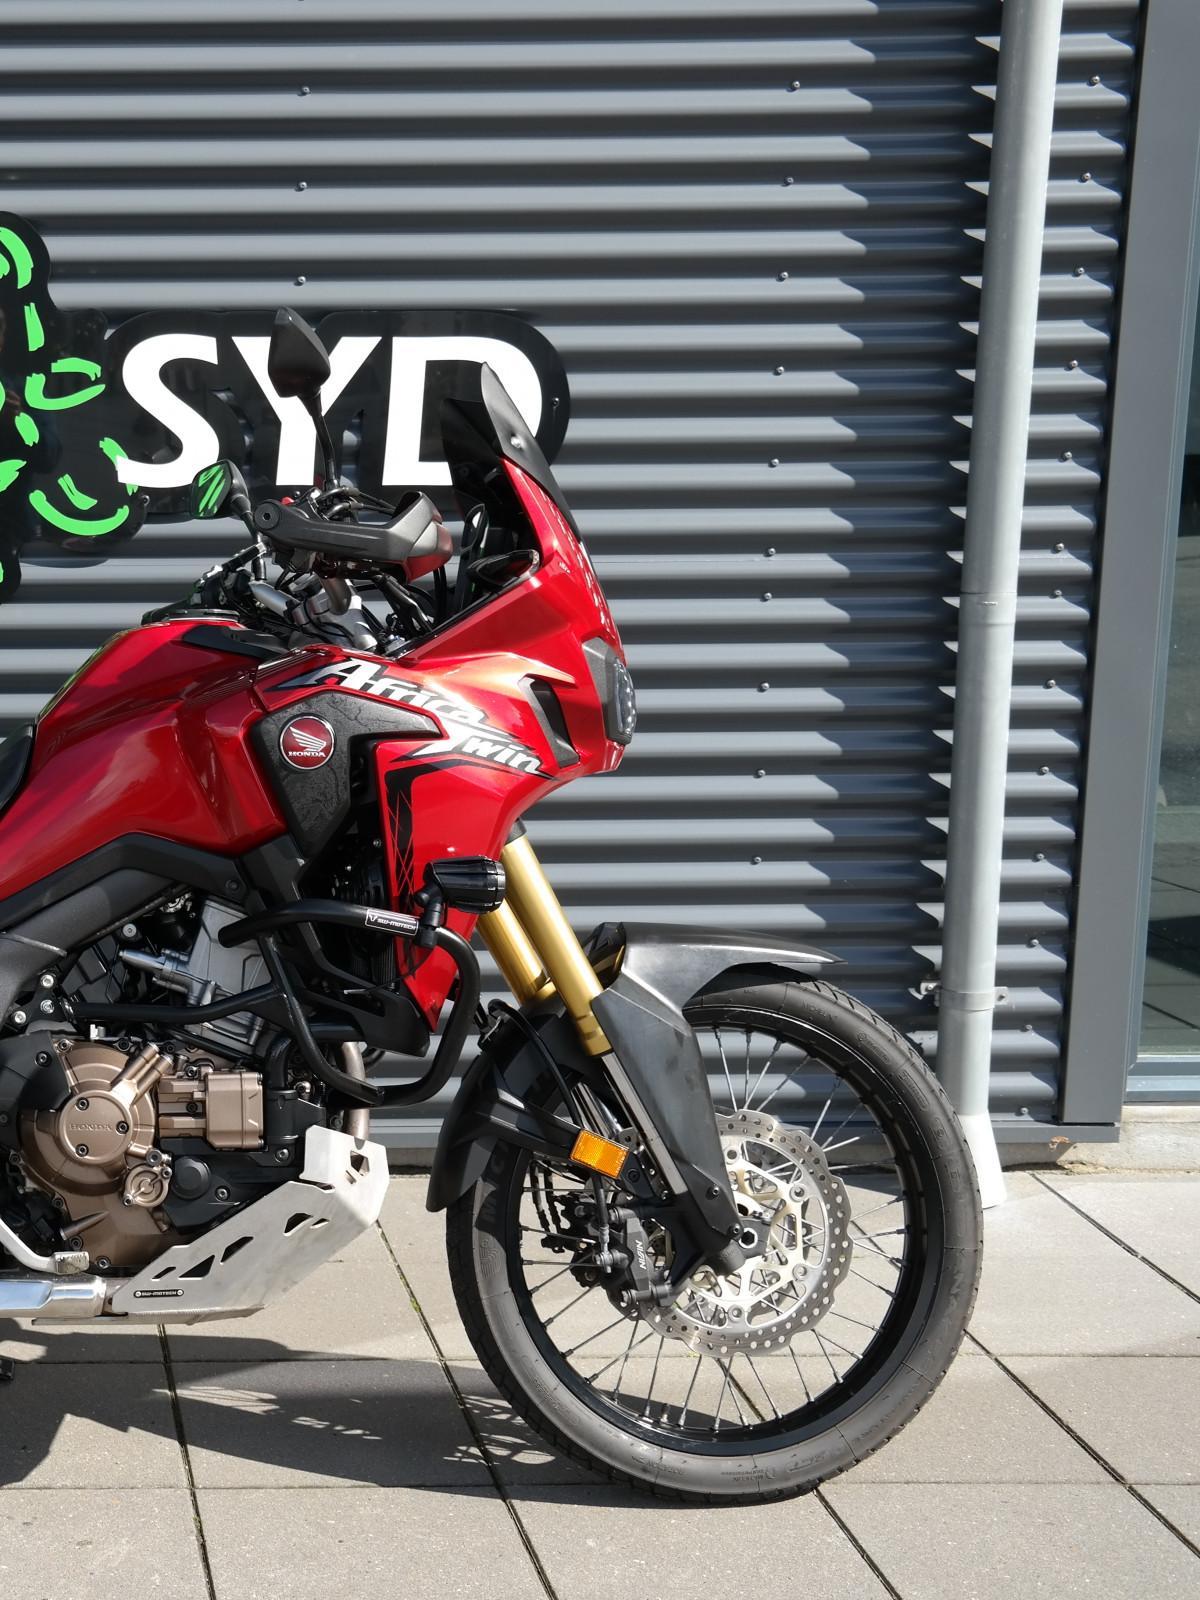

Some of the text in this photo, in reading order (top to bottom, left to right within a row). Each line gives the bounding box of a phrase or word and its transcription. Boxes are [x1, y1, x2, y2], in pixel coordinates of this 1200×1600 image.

[117, 333, 543, 487] SYD
[277, 657, 487, 725] Africa
[412, 720, 546, 774] Twin
[377, 918, 417, 930] SW-MOTECH
[70, 1123, 112, 1131] HONDA
